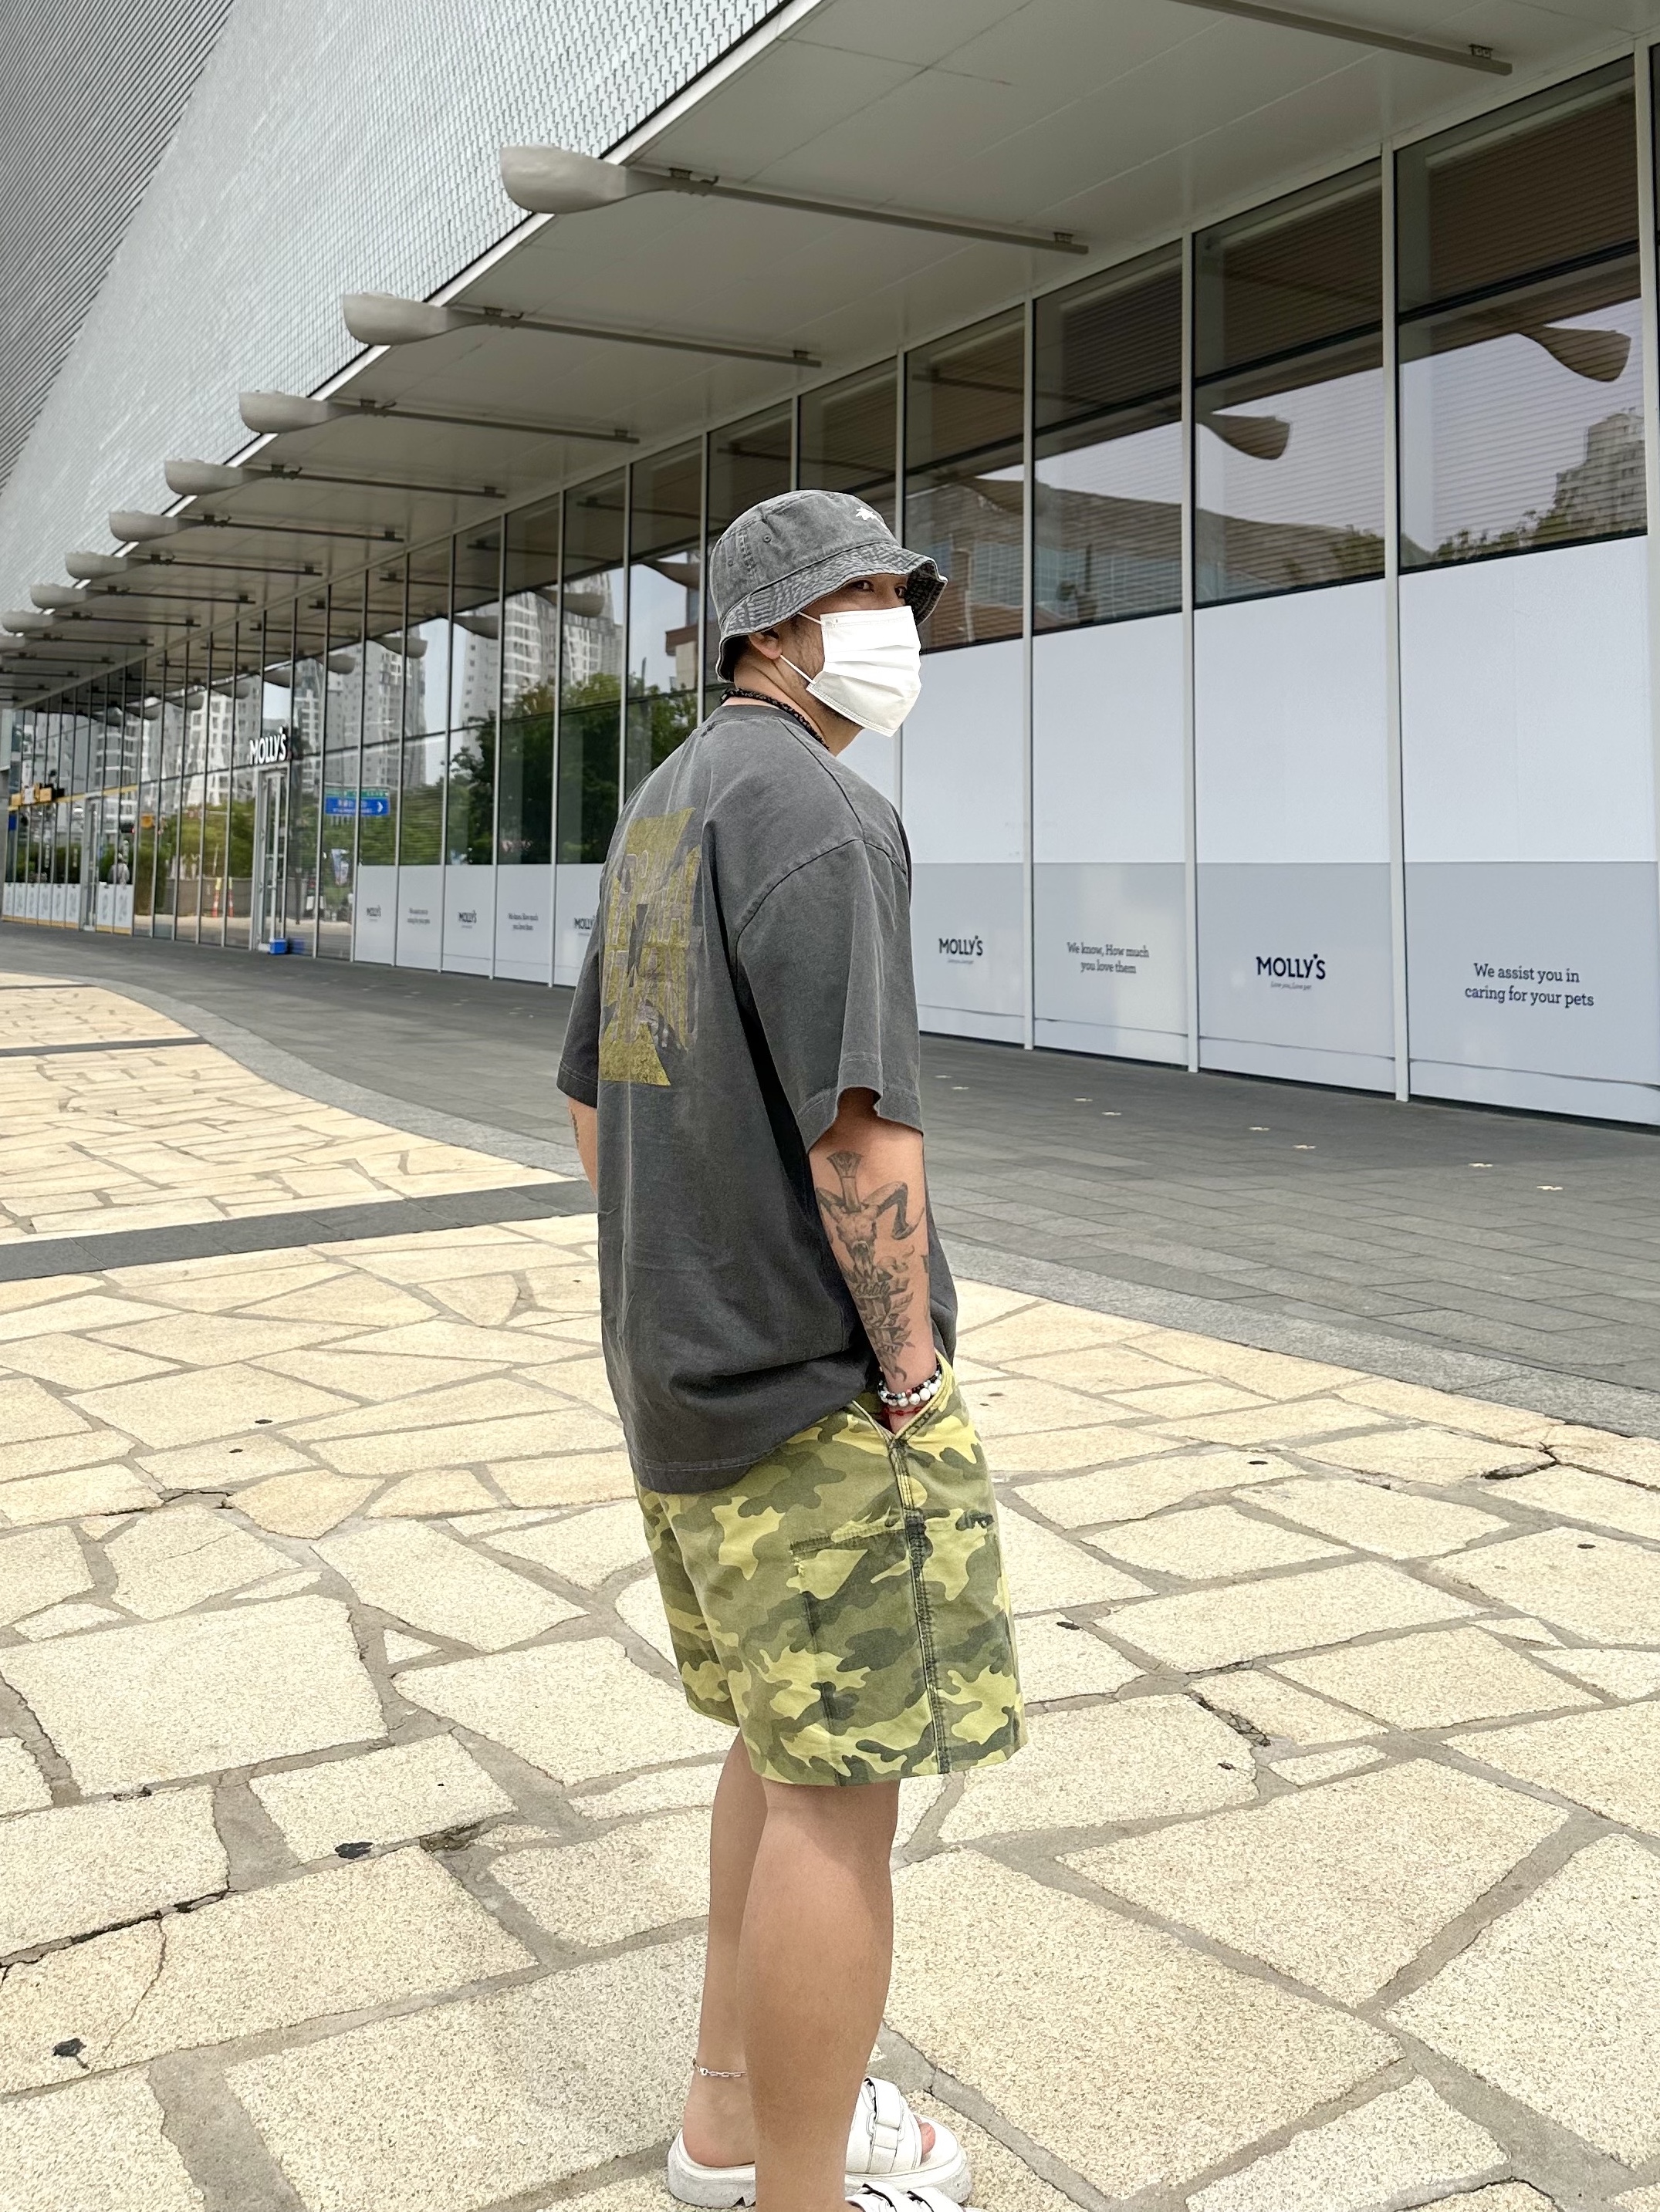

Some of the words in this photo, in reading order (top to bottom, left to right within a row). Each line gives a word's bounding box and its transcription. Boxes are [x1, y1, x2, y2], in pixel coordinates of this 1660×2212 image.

[249, 726, 286, 765] MOLLY'S
[938, 935, 983, 956] MOLLY'S
[1067, 942, 1080, 953] We
[1105, 944, 1124, 956] How
[1126, 945, 1150, 957] much
[1080, 962, 1096, 973] you
[1097, 959, 1114, 972] love
[1115, 960, 1136, 974] them
[1256, 954, 1326, 980] MOLLY'S
[1473, 963, 1495, 978] We
[1498, 965, 1534, 981] assist
[1537, 971, 1563, 984] you
[1566, 968, 1580, 983] in
[1465, 985, 1505, 1003] caring
[1509, 985, 1528, 1001] for
[1530, 992, 1562, 1006] your
[1564, 994, 1594, 1008] pets
